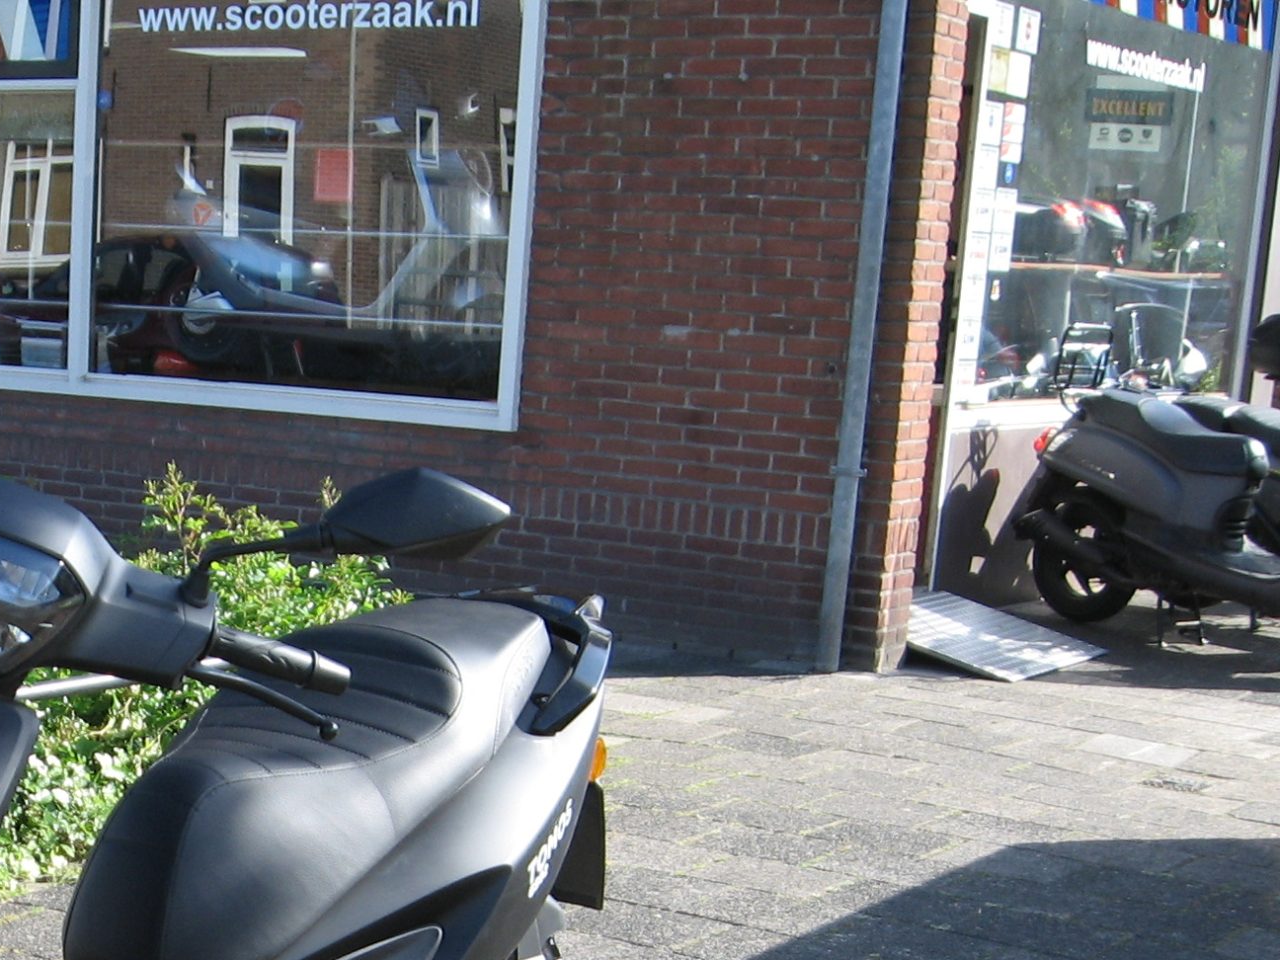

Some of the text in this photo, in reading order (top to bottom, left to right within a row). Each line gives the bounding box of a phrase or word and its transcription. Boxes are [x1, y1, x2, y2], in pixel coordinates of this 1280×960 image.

[139, 0, 479, 31] www.scooterzaak.nl
[1086, 39, 1206, 93] www.scooterzaak.nl
[1092, 97, 1166, 117] EXCELLENT
[527, 798, 572, 885] TOMOS
